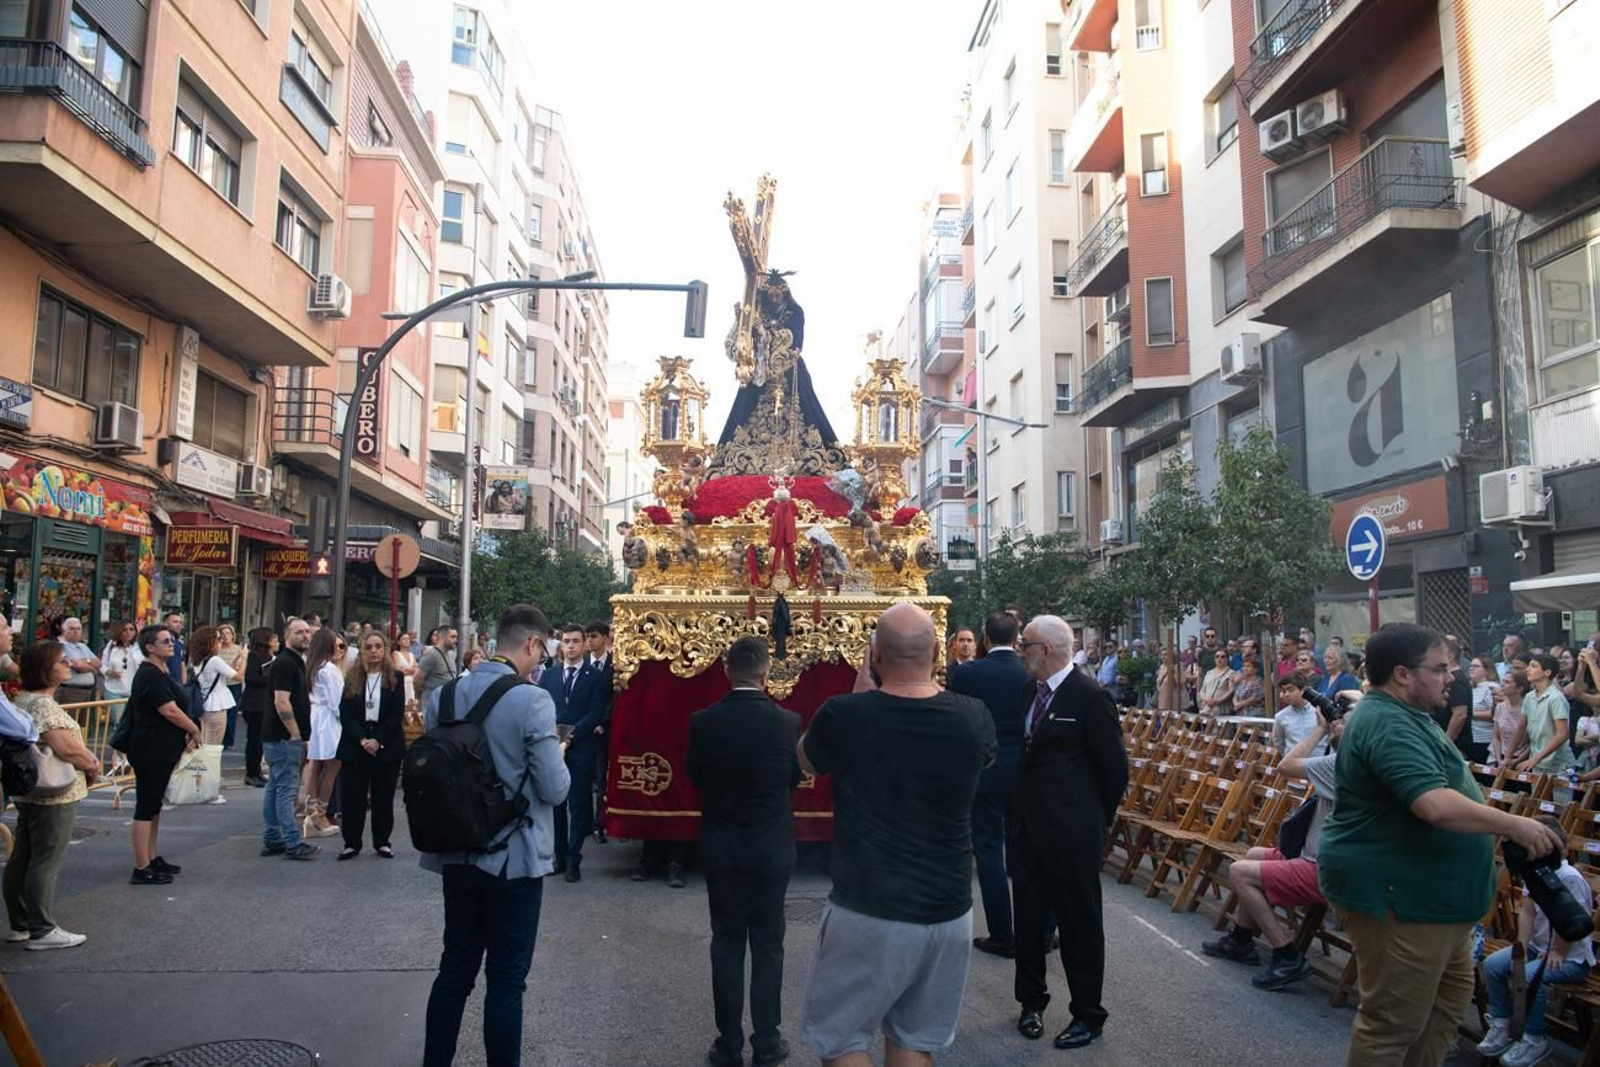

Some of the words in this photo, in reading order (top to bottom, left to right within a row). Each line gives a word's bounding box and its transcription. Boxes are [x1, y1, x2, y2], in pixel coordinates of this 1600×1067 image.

[39, 469, 104, 518] Nomi
[1407, 521, 1416, 532] 10
[171, 530, 229, 543] PERFUMERIA
